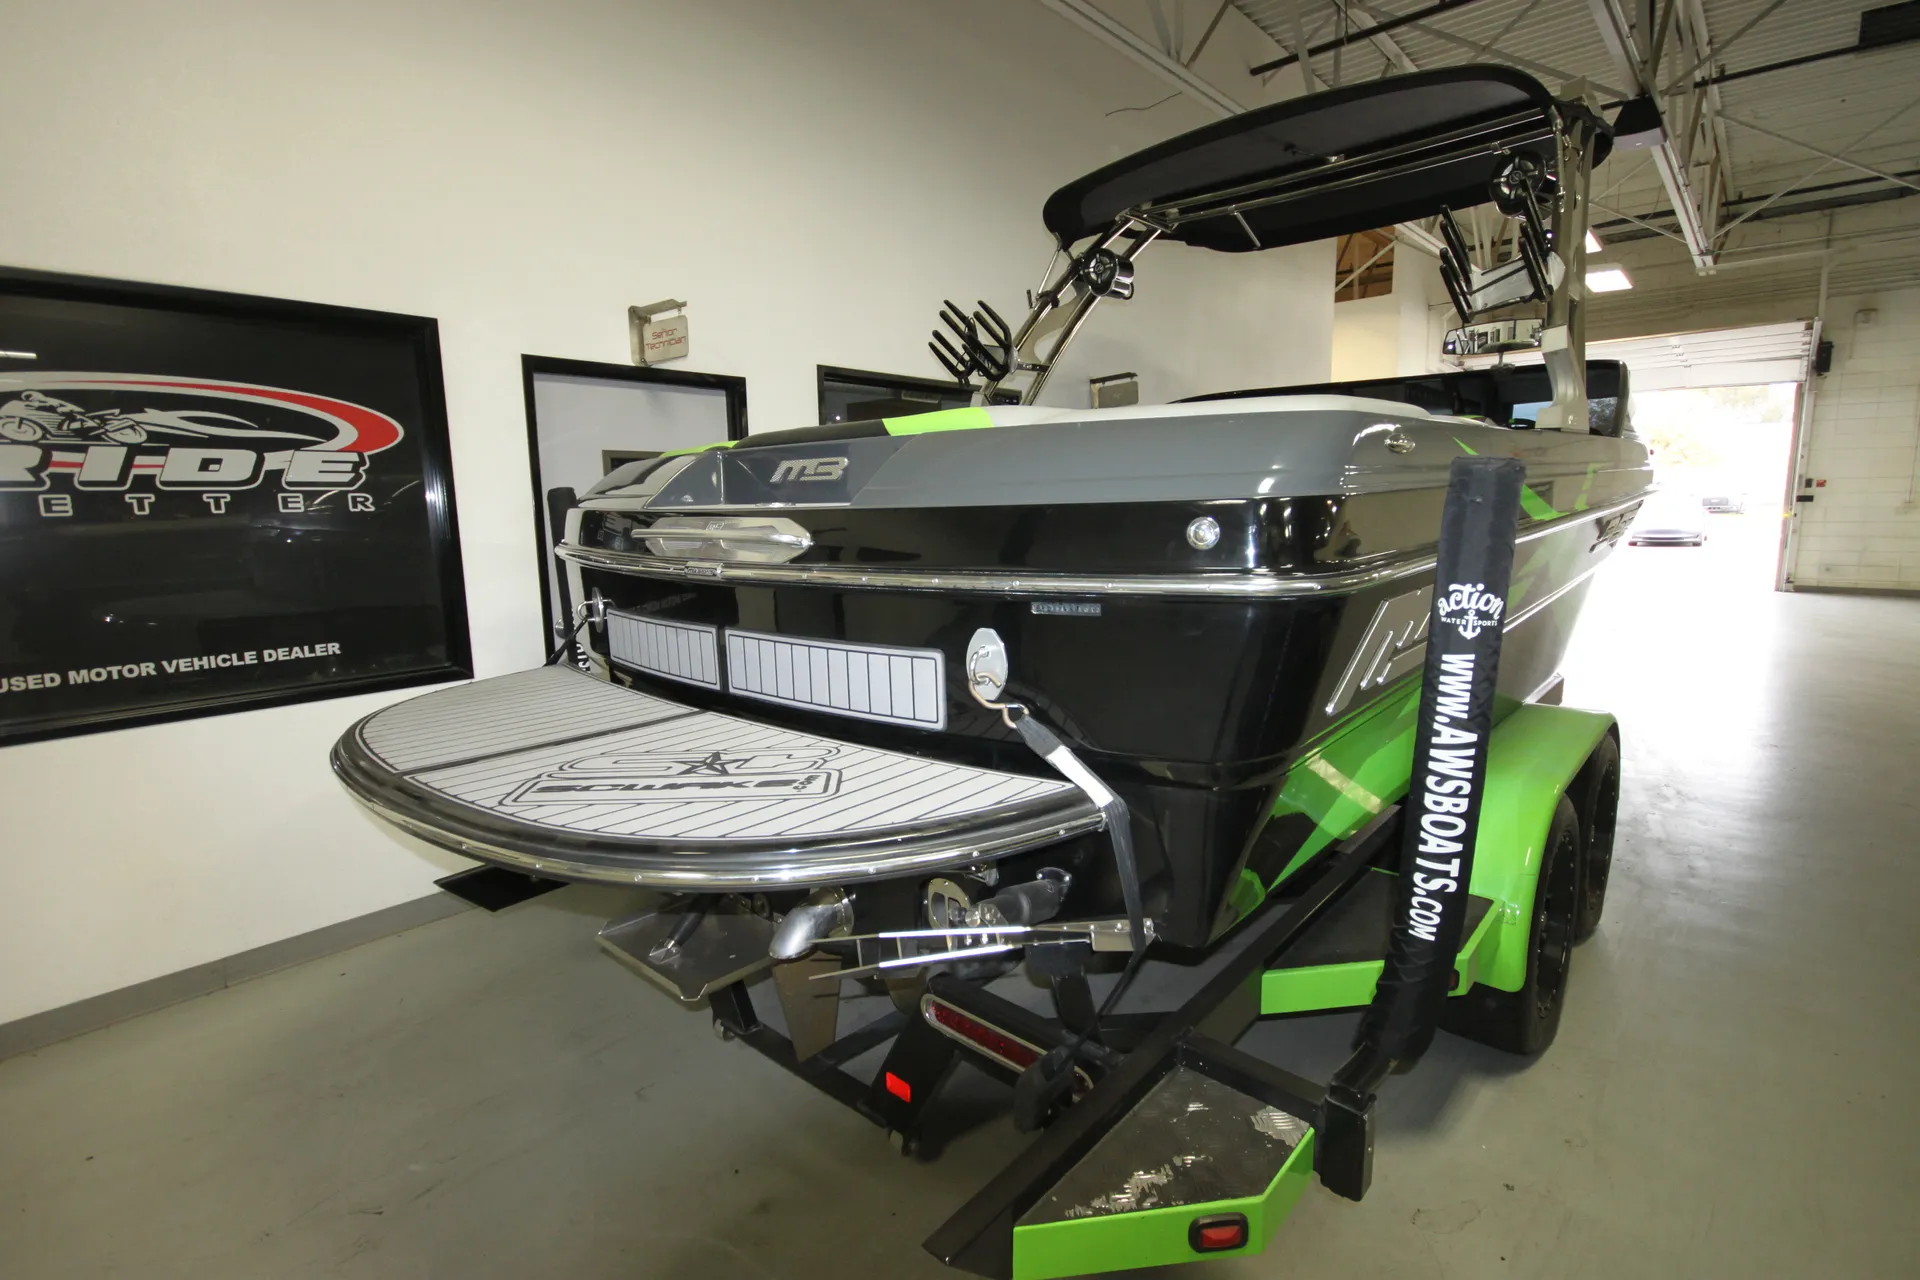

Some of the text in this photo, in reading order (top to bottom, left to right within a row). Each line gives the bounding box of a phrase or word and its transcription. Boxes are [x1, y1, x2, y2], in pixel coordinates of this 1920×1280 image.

[1437, 583, 1504, 620] action
[1441, 616, 1498, 627] WATER SPORTS
[68, 663, 157, 685] MOTOR
[161, 651, 258, 674] VEHICLE
[263, 642, 341, 663] DEALER
[1409, 653, 1476, 942] WWW.AWSBOATS.COM
